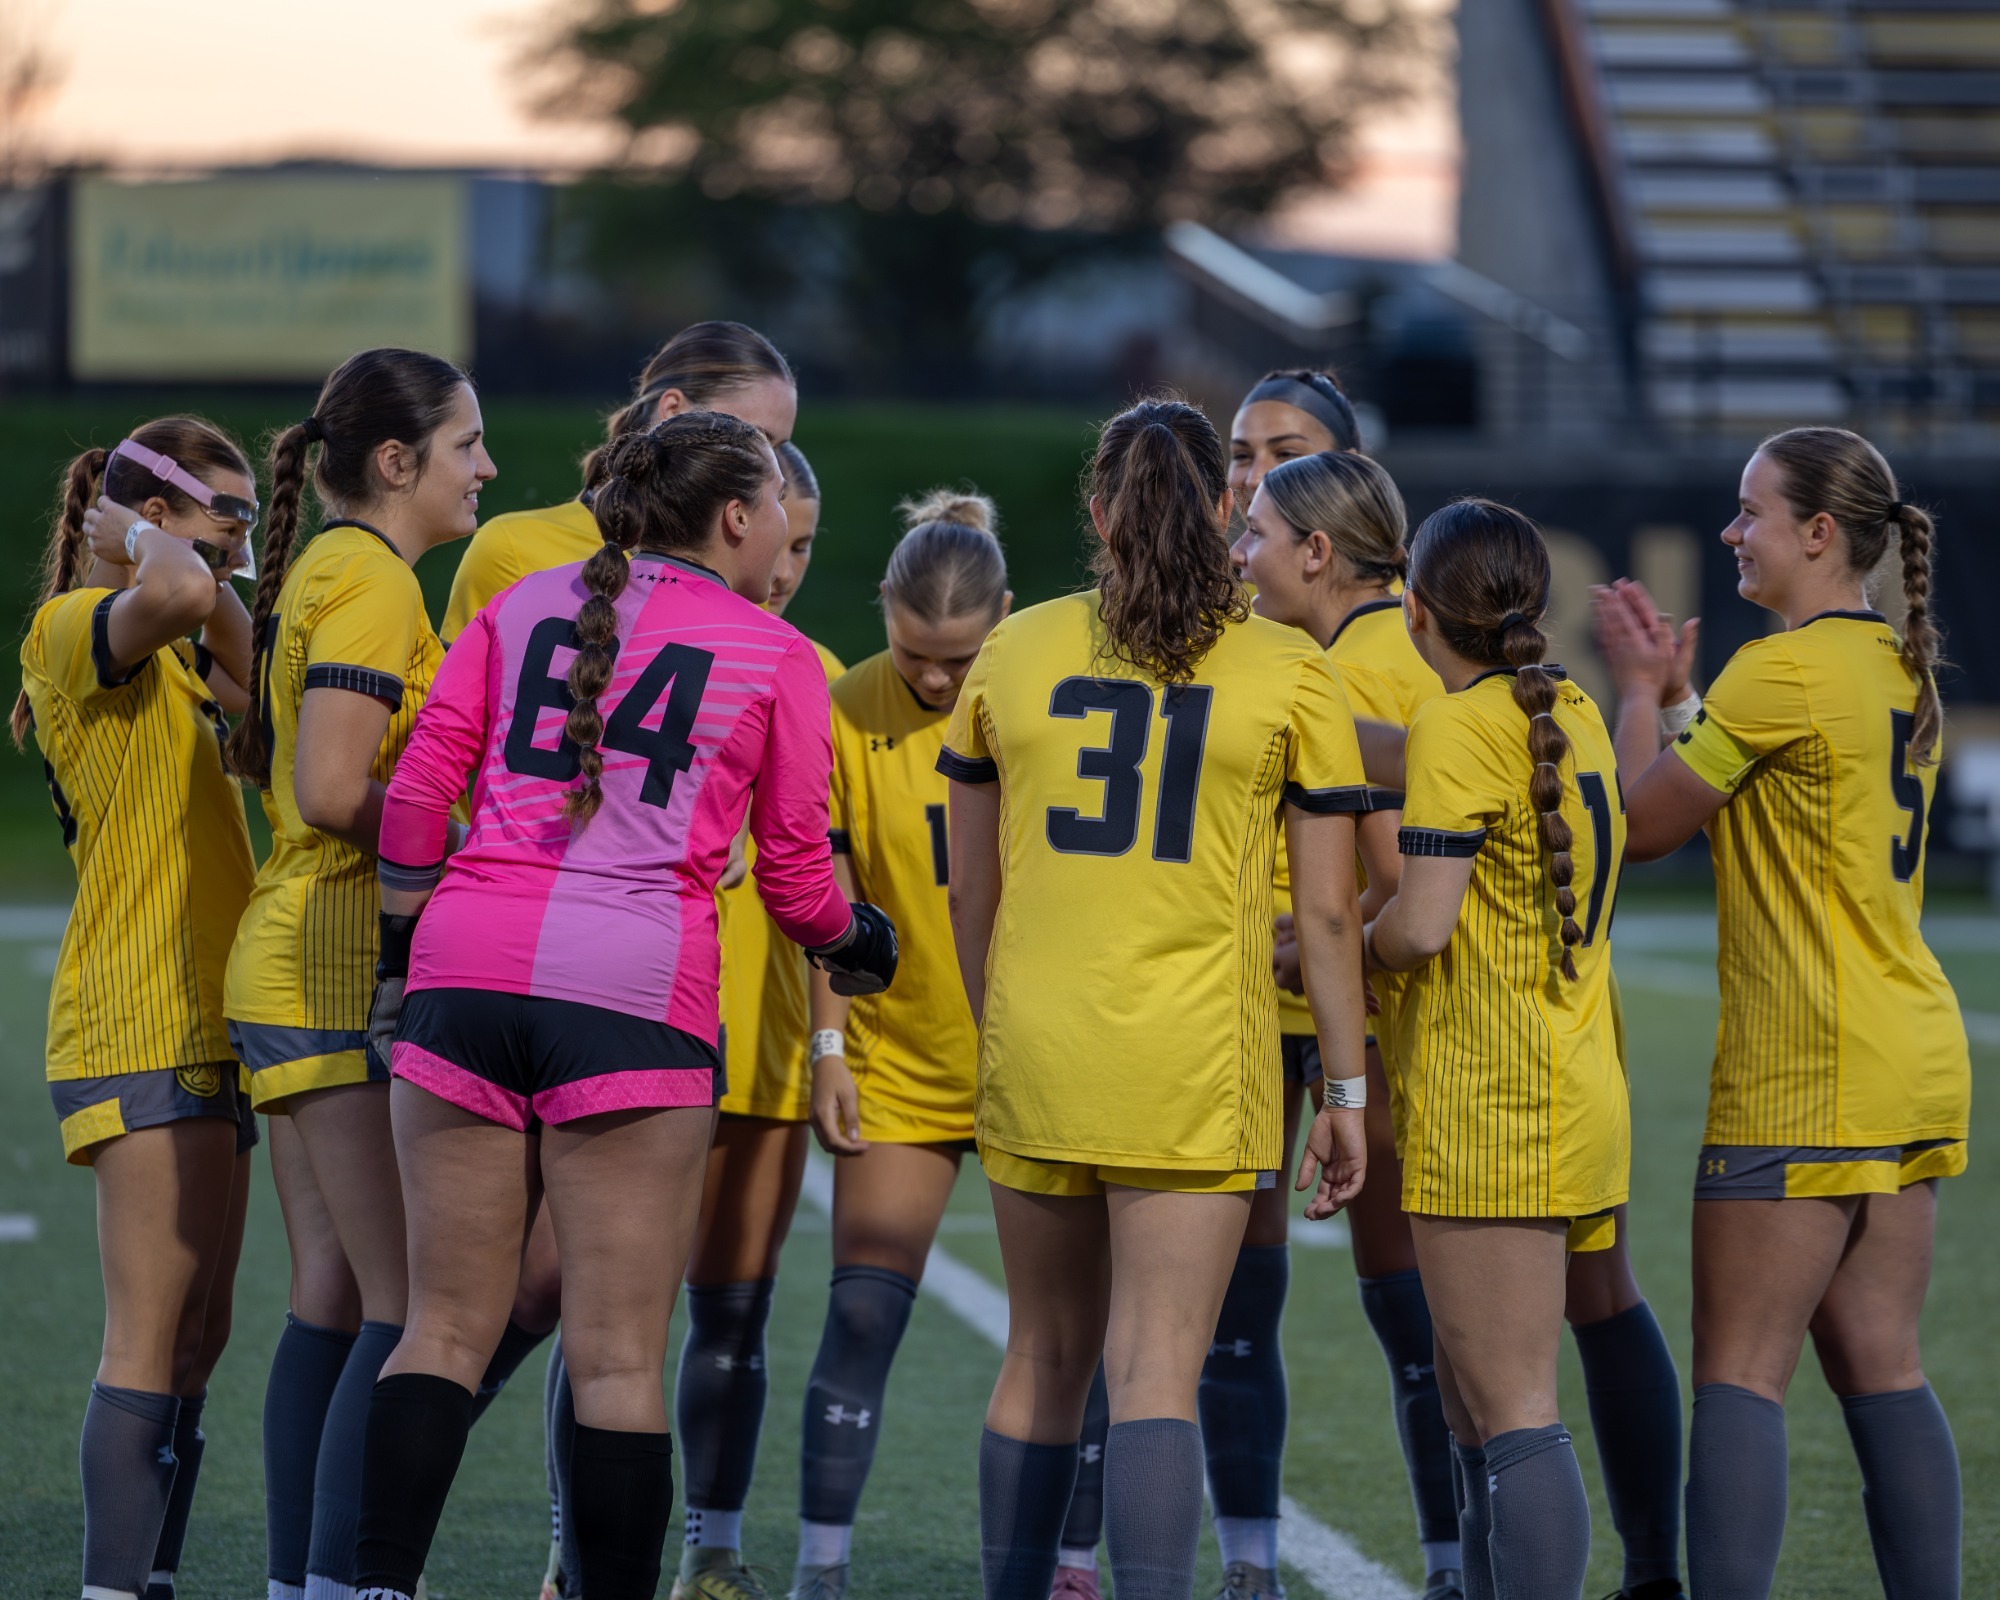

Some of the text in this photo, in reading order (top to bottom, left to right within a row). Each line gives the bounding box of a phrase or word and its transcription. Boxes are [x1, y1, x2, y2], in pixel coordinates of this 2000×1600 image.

[1046, 675, 1214, 864] 31
[1575, 769, 1627, 948] 1
[1890, 708, 1928, 883] 5
